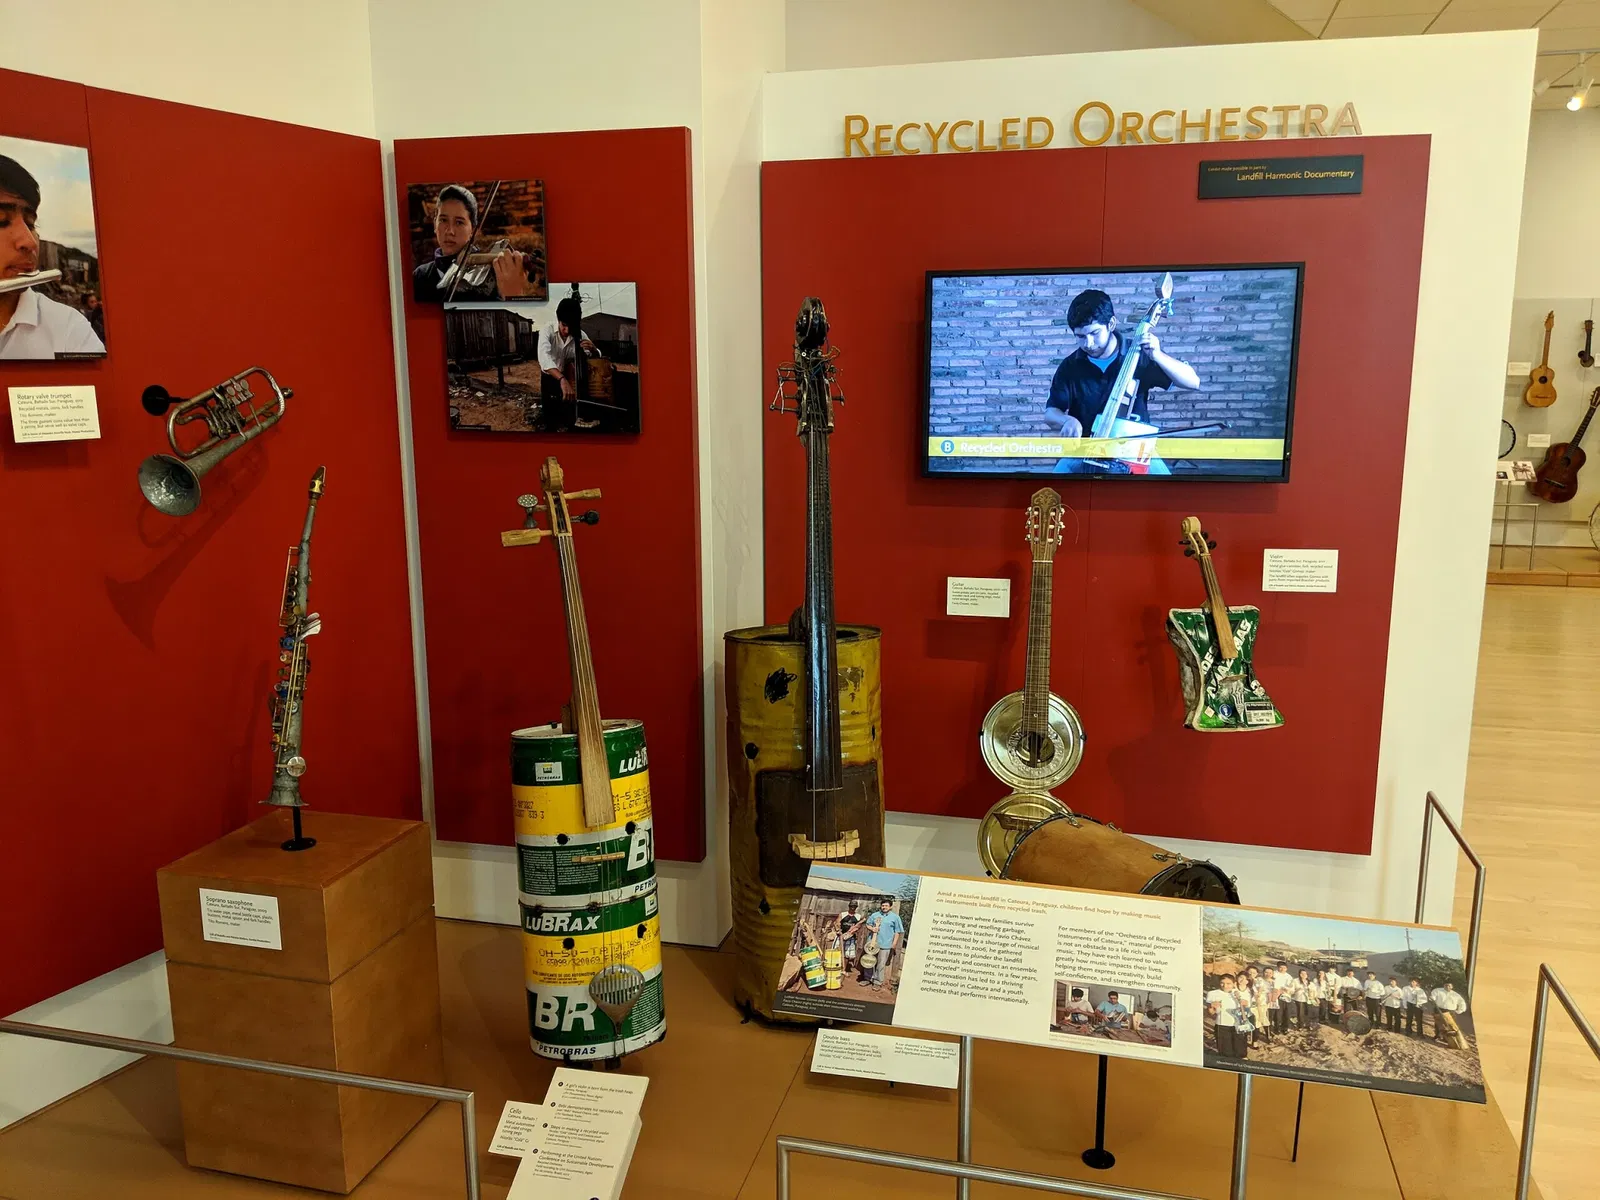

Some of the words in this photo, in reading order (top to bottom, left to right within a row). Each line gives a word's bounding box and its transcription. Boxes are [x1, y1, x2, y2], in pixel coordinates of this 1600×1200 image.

[1236, 172, 1264, 181] Landfill
[1265, 171, 1302, 180] Harmonic
[1304, 170, 1355, 179] Documentary
[960, 442, 1005, 454] Recycled
[1009, 442, 1063, 453] Orchestra
[1032, 901, 1058, 909] Paraguay,
[526, 912, 600, 932] LUBRAX
[1058, 933, 1092, 941] Instruments
[929, 941, 962, 950] instruments.
[961, 967, 995, 976] instruments.
[1055, 962, 1076, 971] helping
[1001, 980, 1023, 988] thriving
[1054, 971, 1098, 979] self-confidence,
[1146, 983, 1181, 992] community.
[988, 995, 1029, 1005] internationally.
[534, 988, 597, 1032] BR
[539, 1044, 596, 1056] PETROBRAS
